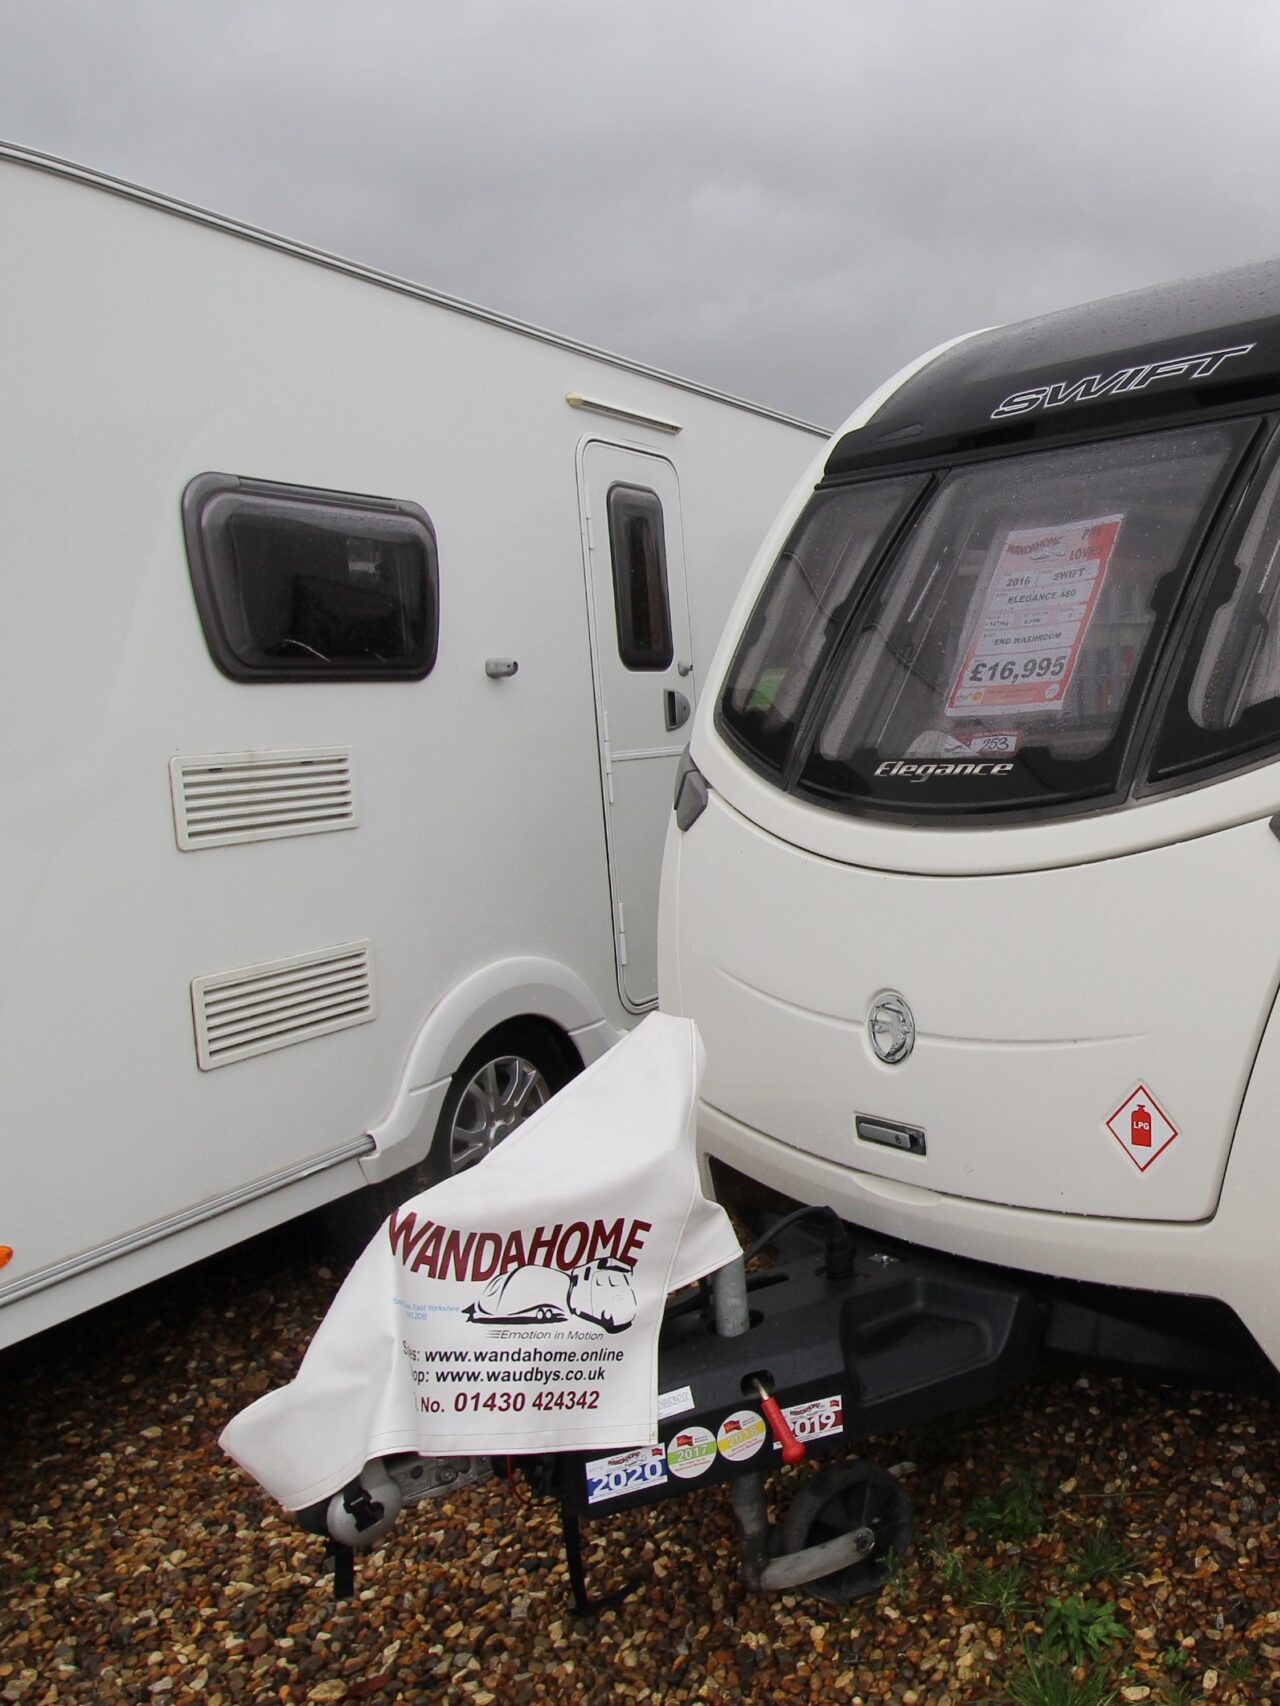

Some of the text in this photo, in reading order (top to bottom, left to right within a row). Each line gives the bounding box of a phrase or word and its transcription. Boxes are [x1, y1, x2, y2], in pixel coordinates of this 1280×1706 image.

[990, 343, 1257, 419] SWIFT
[1053, 567, 1085, 581] SWIFT
[1007, 592, 1058, 604] ELEGANCE
[969, 655, 1067, 684] £16,995
[980, 737, 1009, 752] 253
[873, 760, 1014, 783] Elegance
[1133, 1120, 1150, 1131] LPG
[388, 1208, 652, 1282] WANDAHOME
[500, 1329, 604, 1341] Emotion in Motion
[424, 1347, 624, 1363] www.wandahome.online
[435, 1366, 605, 1385] www.waudbys.co.uk
[420, 1396, 446, 1413] No.
[454, 1391, 526, 1413] 01430
[531, 1390, 600, 1412] 424342
[790, 1412, 836, 1438] 019
[728, 1425, 759, 1447] 2018
[677, 1444, 709, 1462] 2017
[592, 1460, 663, 1497] 2020
